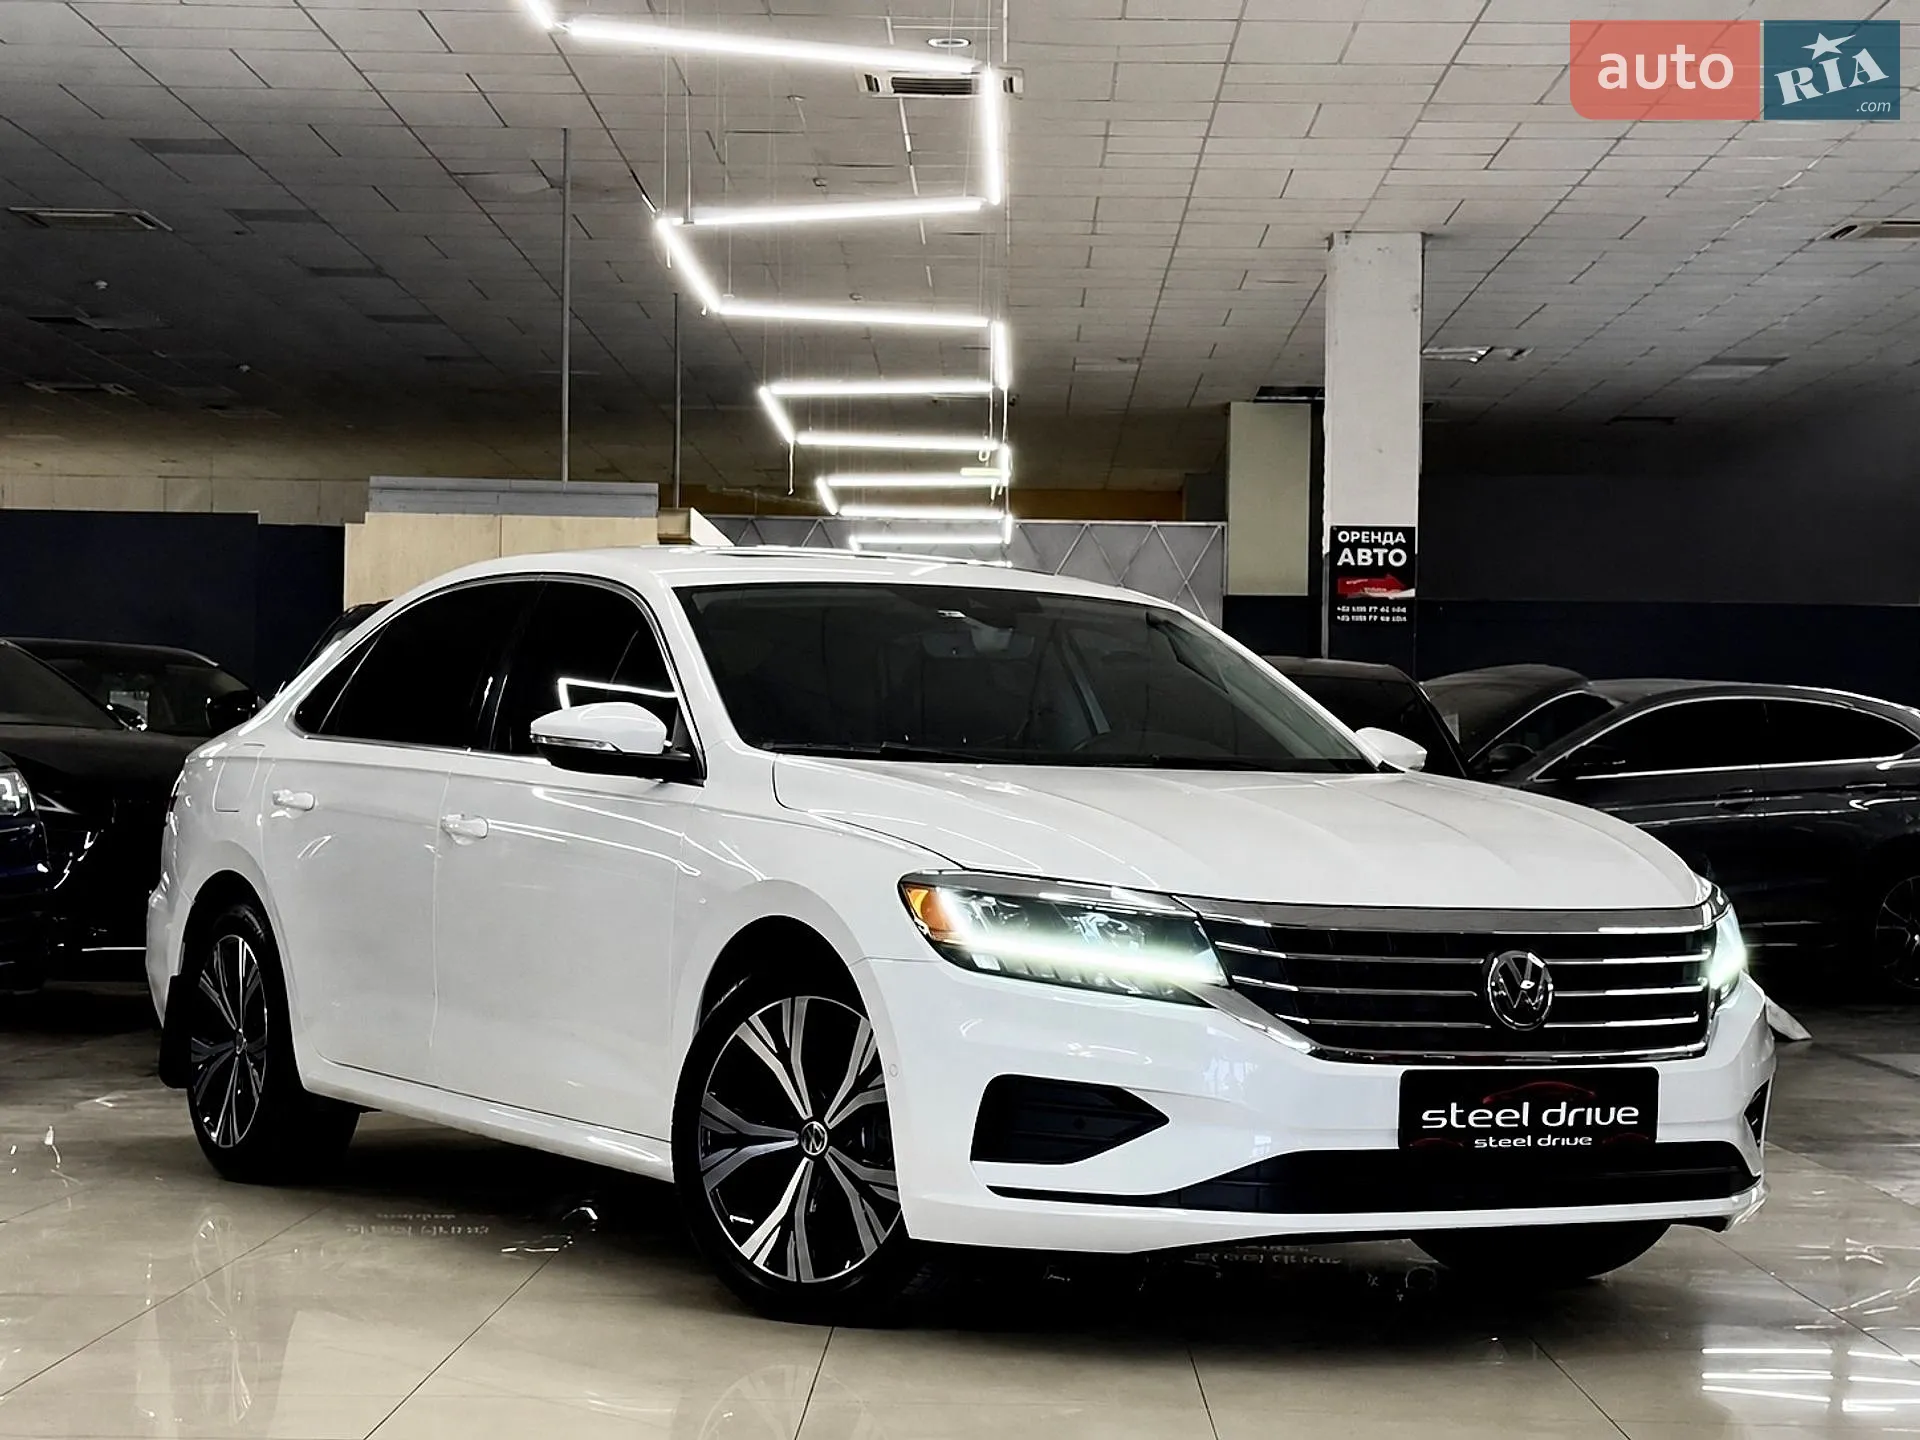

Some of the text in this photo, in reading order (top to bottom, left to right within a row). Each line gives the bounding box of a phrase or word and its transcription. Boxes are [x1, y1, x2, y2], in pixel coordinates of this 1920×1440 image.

[1337, 530, 1407, 546] ОРЕНДА
[1336, 547, 1407, 567] АВТО
[1421, 1101, 1640, 1129] steel drive
[1474, 1134, 1593, 1149] steel drive
